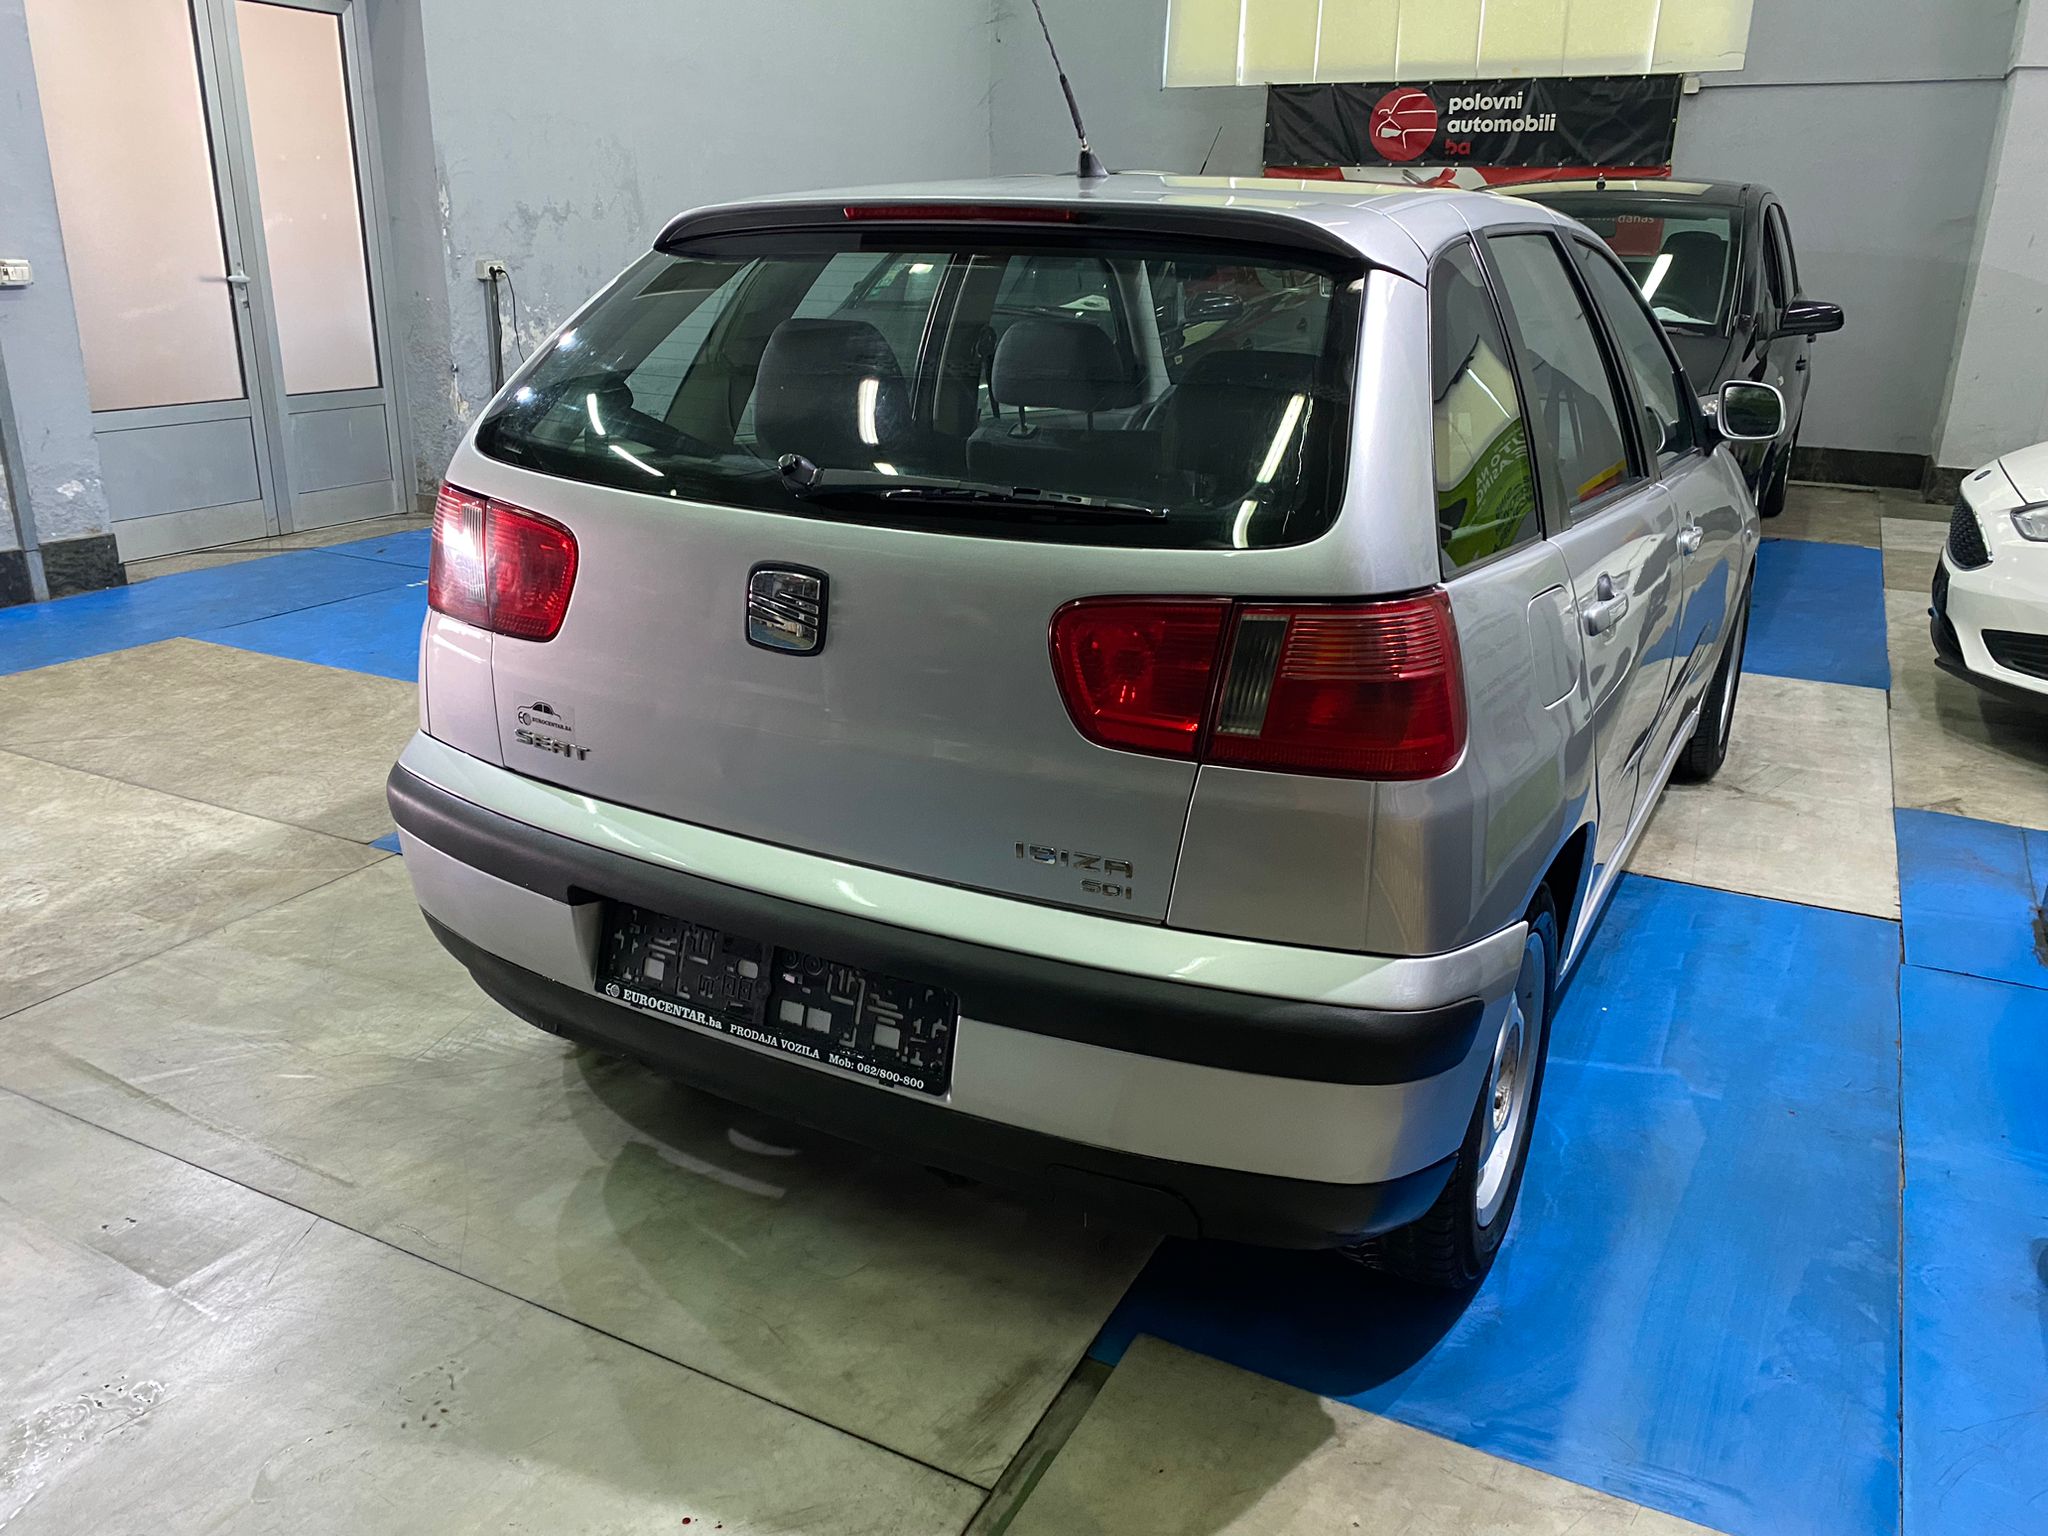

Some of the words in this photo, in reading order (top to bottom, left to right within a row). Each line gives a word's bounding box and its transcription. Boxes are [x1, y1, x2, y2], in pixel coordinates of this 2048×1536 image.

[1448, 91, 1523, 115] polovni
[1447, 113, 1557, 133] automobili
[515, 728, 591, 761] SEAT
[1014, 841, 1133, 879] IBIZA
[1080, 878, 1132, 899] SDI
[623, 988, 722, 1030] EUROCENTAR.ba
[730, 1023, 778, 1047] PRODAJA
[781, 1038, 820, 1060] VOZILA
[828, 1053, 855, 1070] Mob:
[857, 1062, 925, 1090] 062/800-800
